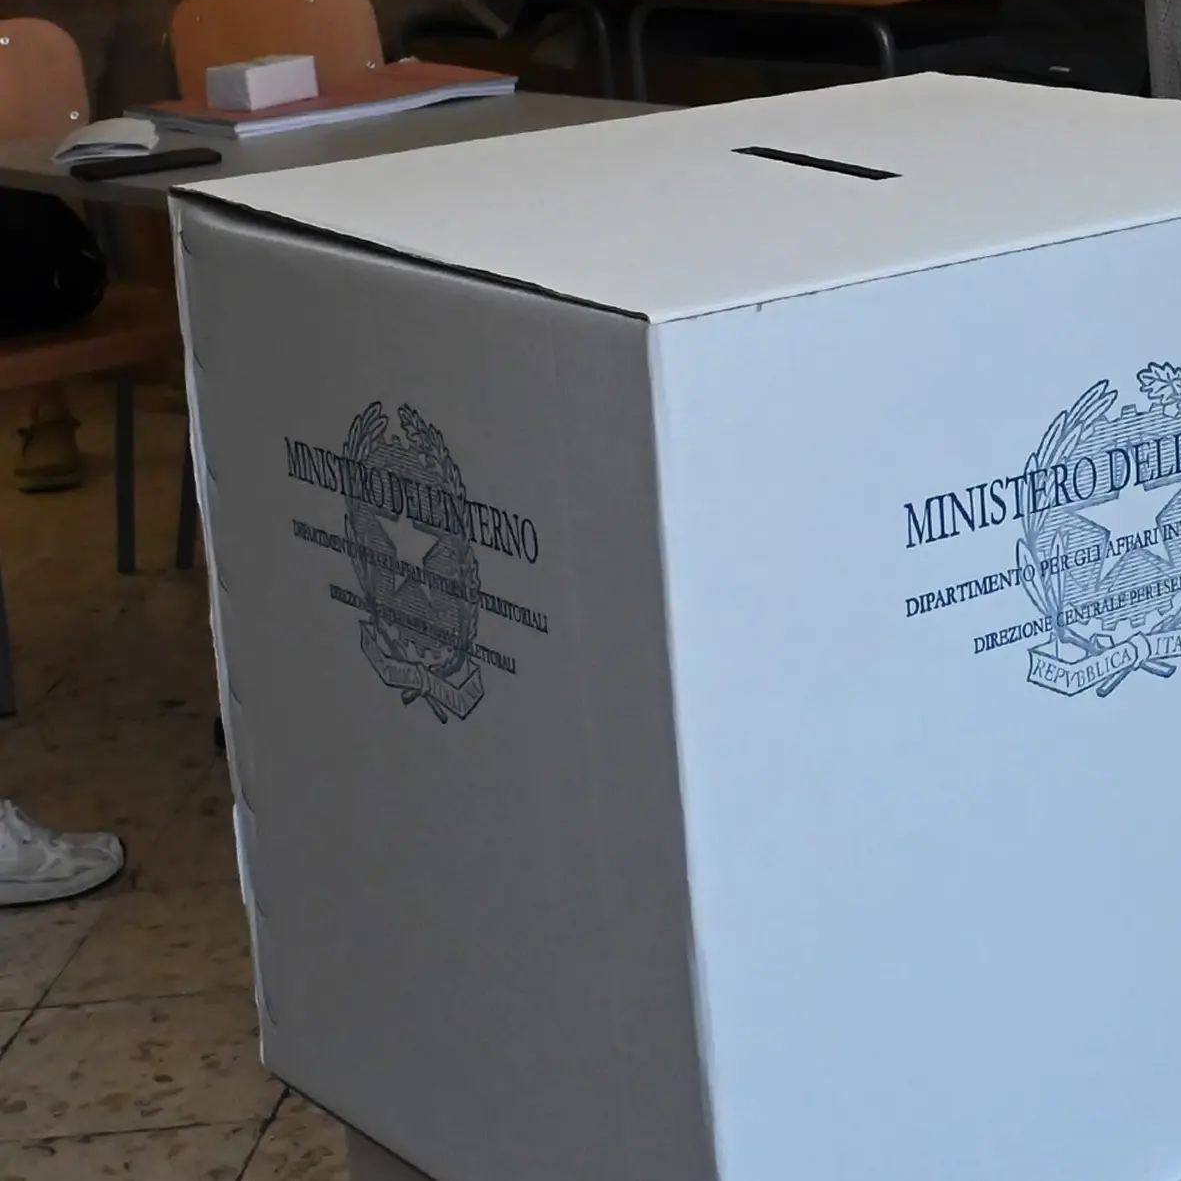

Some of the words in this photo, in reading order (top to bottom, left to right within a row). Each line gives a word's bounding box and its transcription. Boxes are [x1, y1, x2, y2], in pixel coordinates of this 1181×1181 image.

[284, 436, 386, 508] MINISTERO
[385, 469, 540, 565] DELL'INTERNO
[903, 456, 1097, 549] MINISTERO
[904, 564, 1036, 618] DIPARTIMENTO
[1040, 553, 1069, 578] PER
[1073, 543, 1102, 567] GLI
[1106, 527, 1160, 559] AFFARI
[973, 616, 1053, 655] DIREZIONE
[1056, 593, 1126, 628] CENTRALE
[1129, 586, 1157, 607] PER
